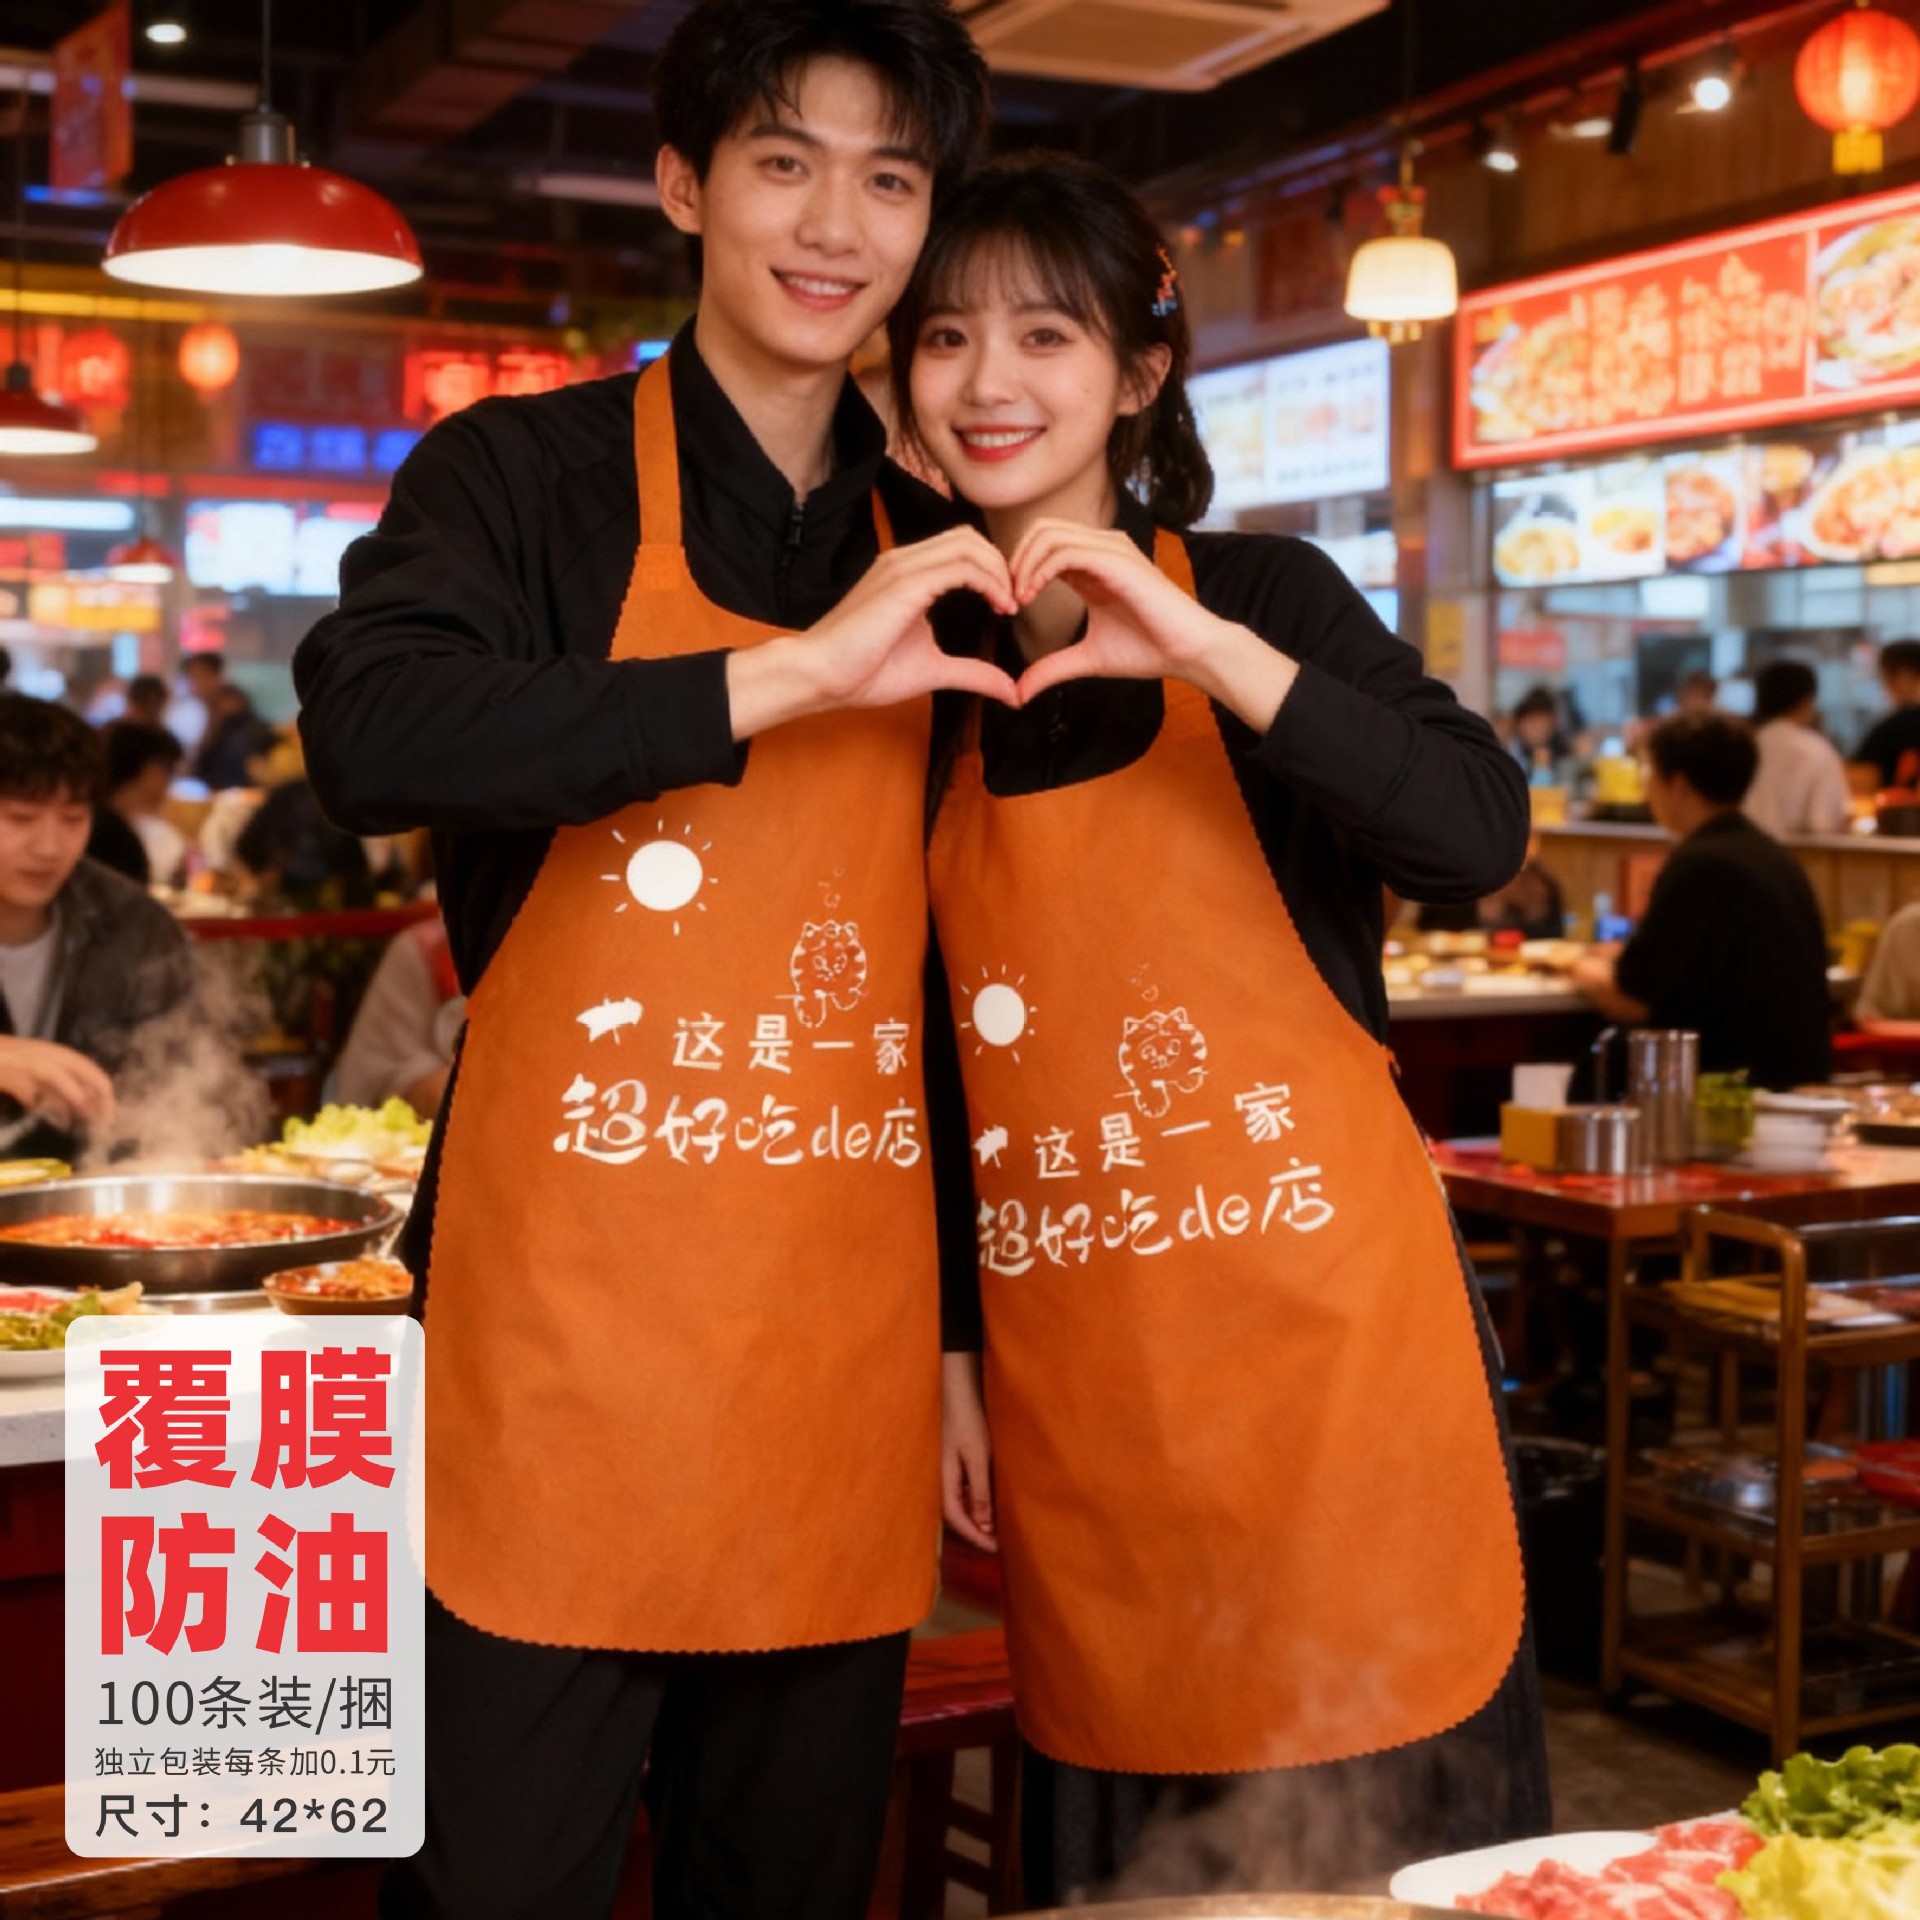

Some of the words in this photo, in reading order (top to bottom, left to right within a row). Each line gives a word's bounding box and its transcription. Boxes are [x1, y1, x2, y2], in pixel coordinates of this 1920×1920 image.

[673, 1013, 909, 1074] 这是一家
[553, 1073, 921, 1168] 超好吃de店
[1033, 1082, 1295, 1179] 这是一家
[977, 1157, 1335, 1277] 超好吃de店
